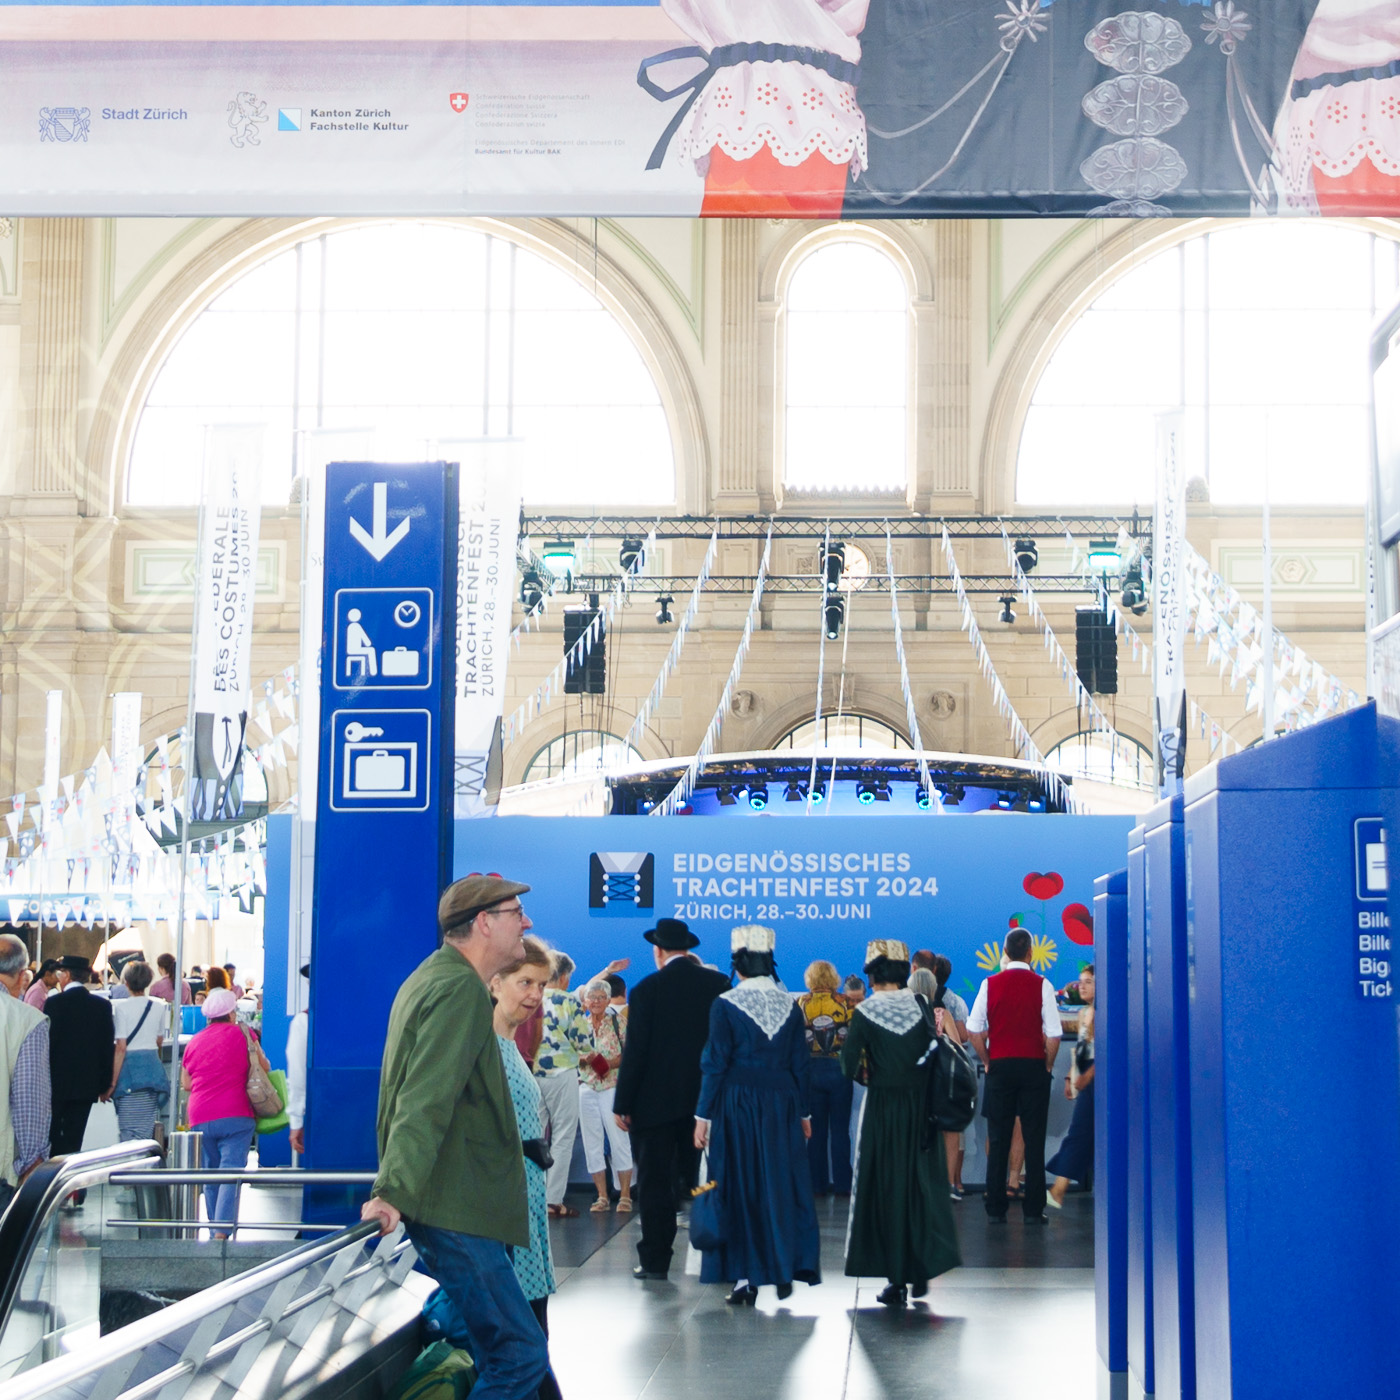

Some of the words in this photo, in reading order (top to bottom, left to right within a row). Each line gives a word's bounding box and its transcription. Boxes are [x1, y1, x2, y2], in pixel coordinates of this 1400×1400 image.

[102, 108, 139, 120] Stadt
[143, 106, 188, 120] Zürich
[310, 108, 352, 118] Kanton
[355, 107, 392, 118] Zürich
[310, 121, 371, 131] Fachstelle
[374, 121, 410, 131] Kultur
[240, 509, 250, 552] JUIN
[220, 507, 240, 641] COSTUMES
[463, 519, 484, 698] TRACHTENFEST
[674, 850, 910, 872] EIDGENÖSSISCHES
[673, 878, 869, 896] TRACHTENFEST
[877, 877, 938, 896] 2024
[673, 902, 752, 921] ZÜRICH,
